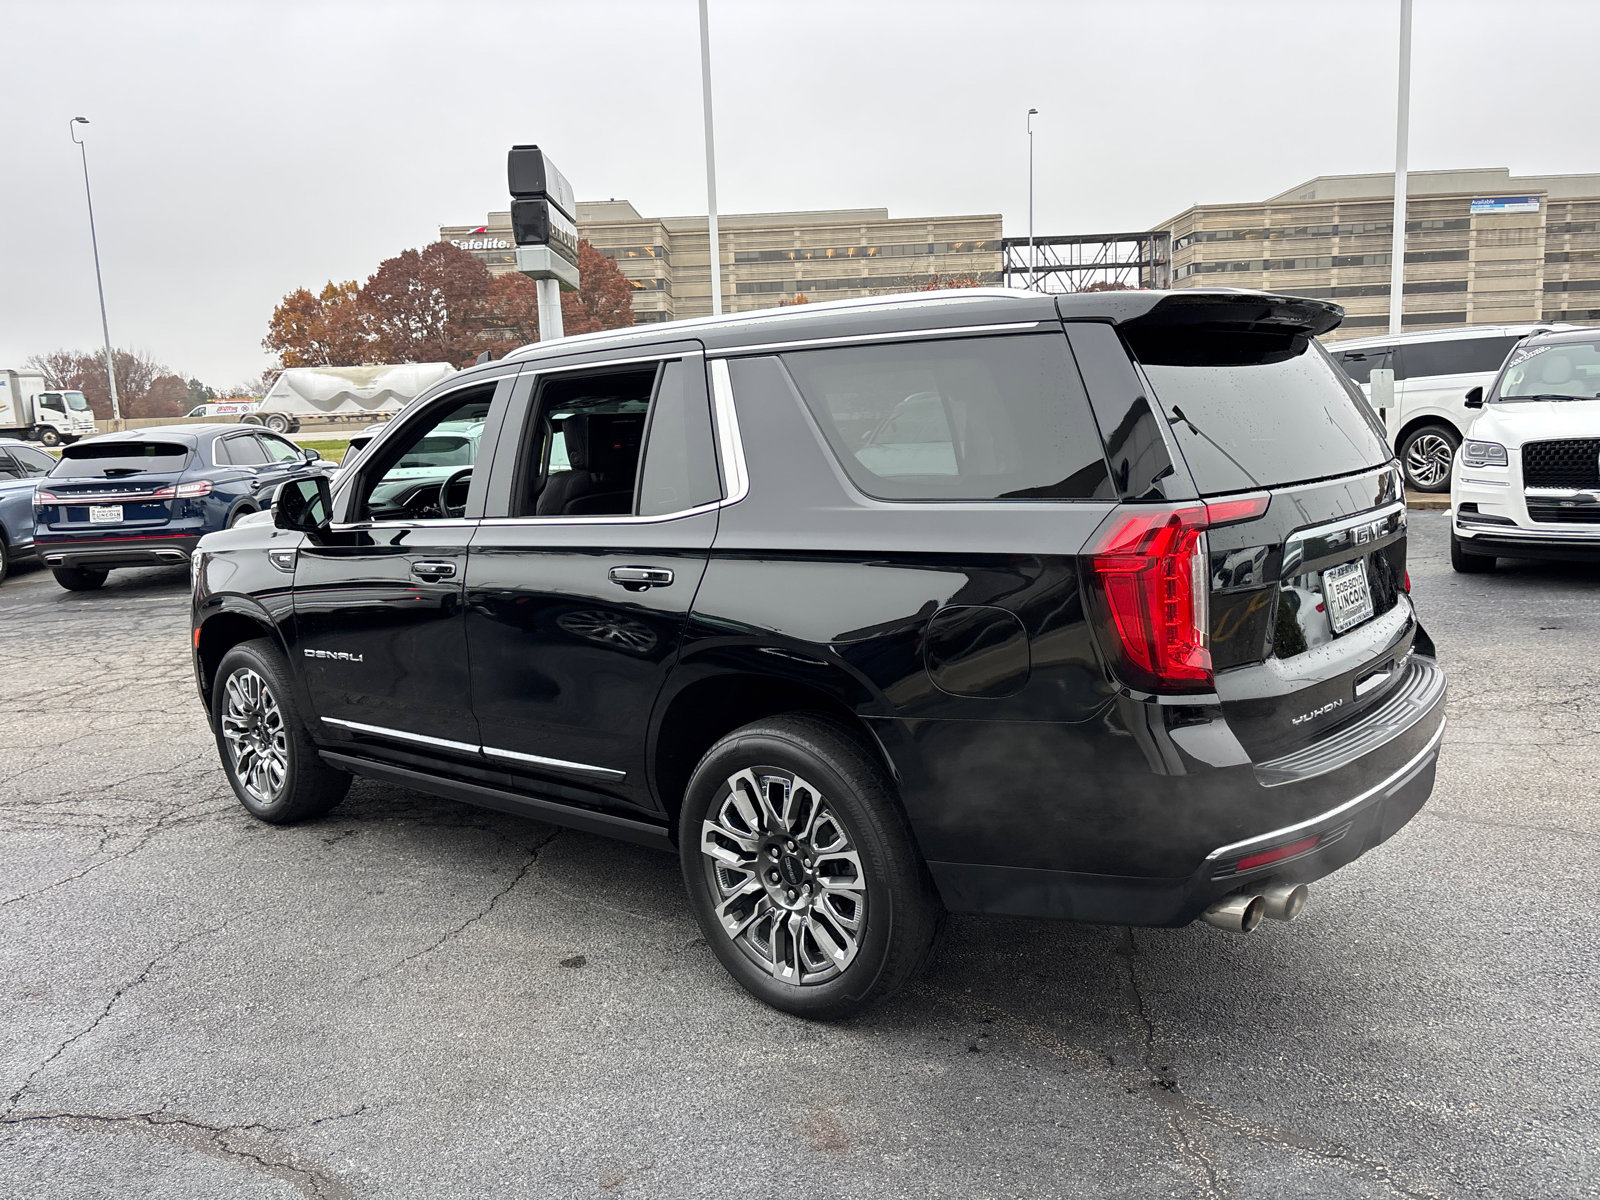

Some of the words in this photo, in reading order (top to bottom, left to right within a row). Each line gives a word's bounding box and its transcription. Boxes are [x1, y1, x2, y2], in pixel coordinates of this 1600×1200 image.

[66, 487, 141, 495] LINCOLN
[1350, 517, 1389, 546] GMC
[1335, 574, 1364, 595] BOB-BOYD
[1336, 586, 1367, 610] LINCOLN
[304, 648, 364, 662] DENALI
[1292, 698, 1343, 725] YUKON
